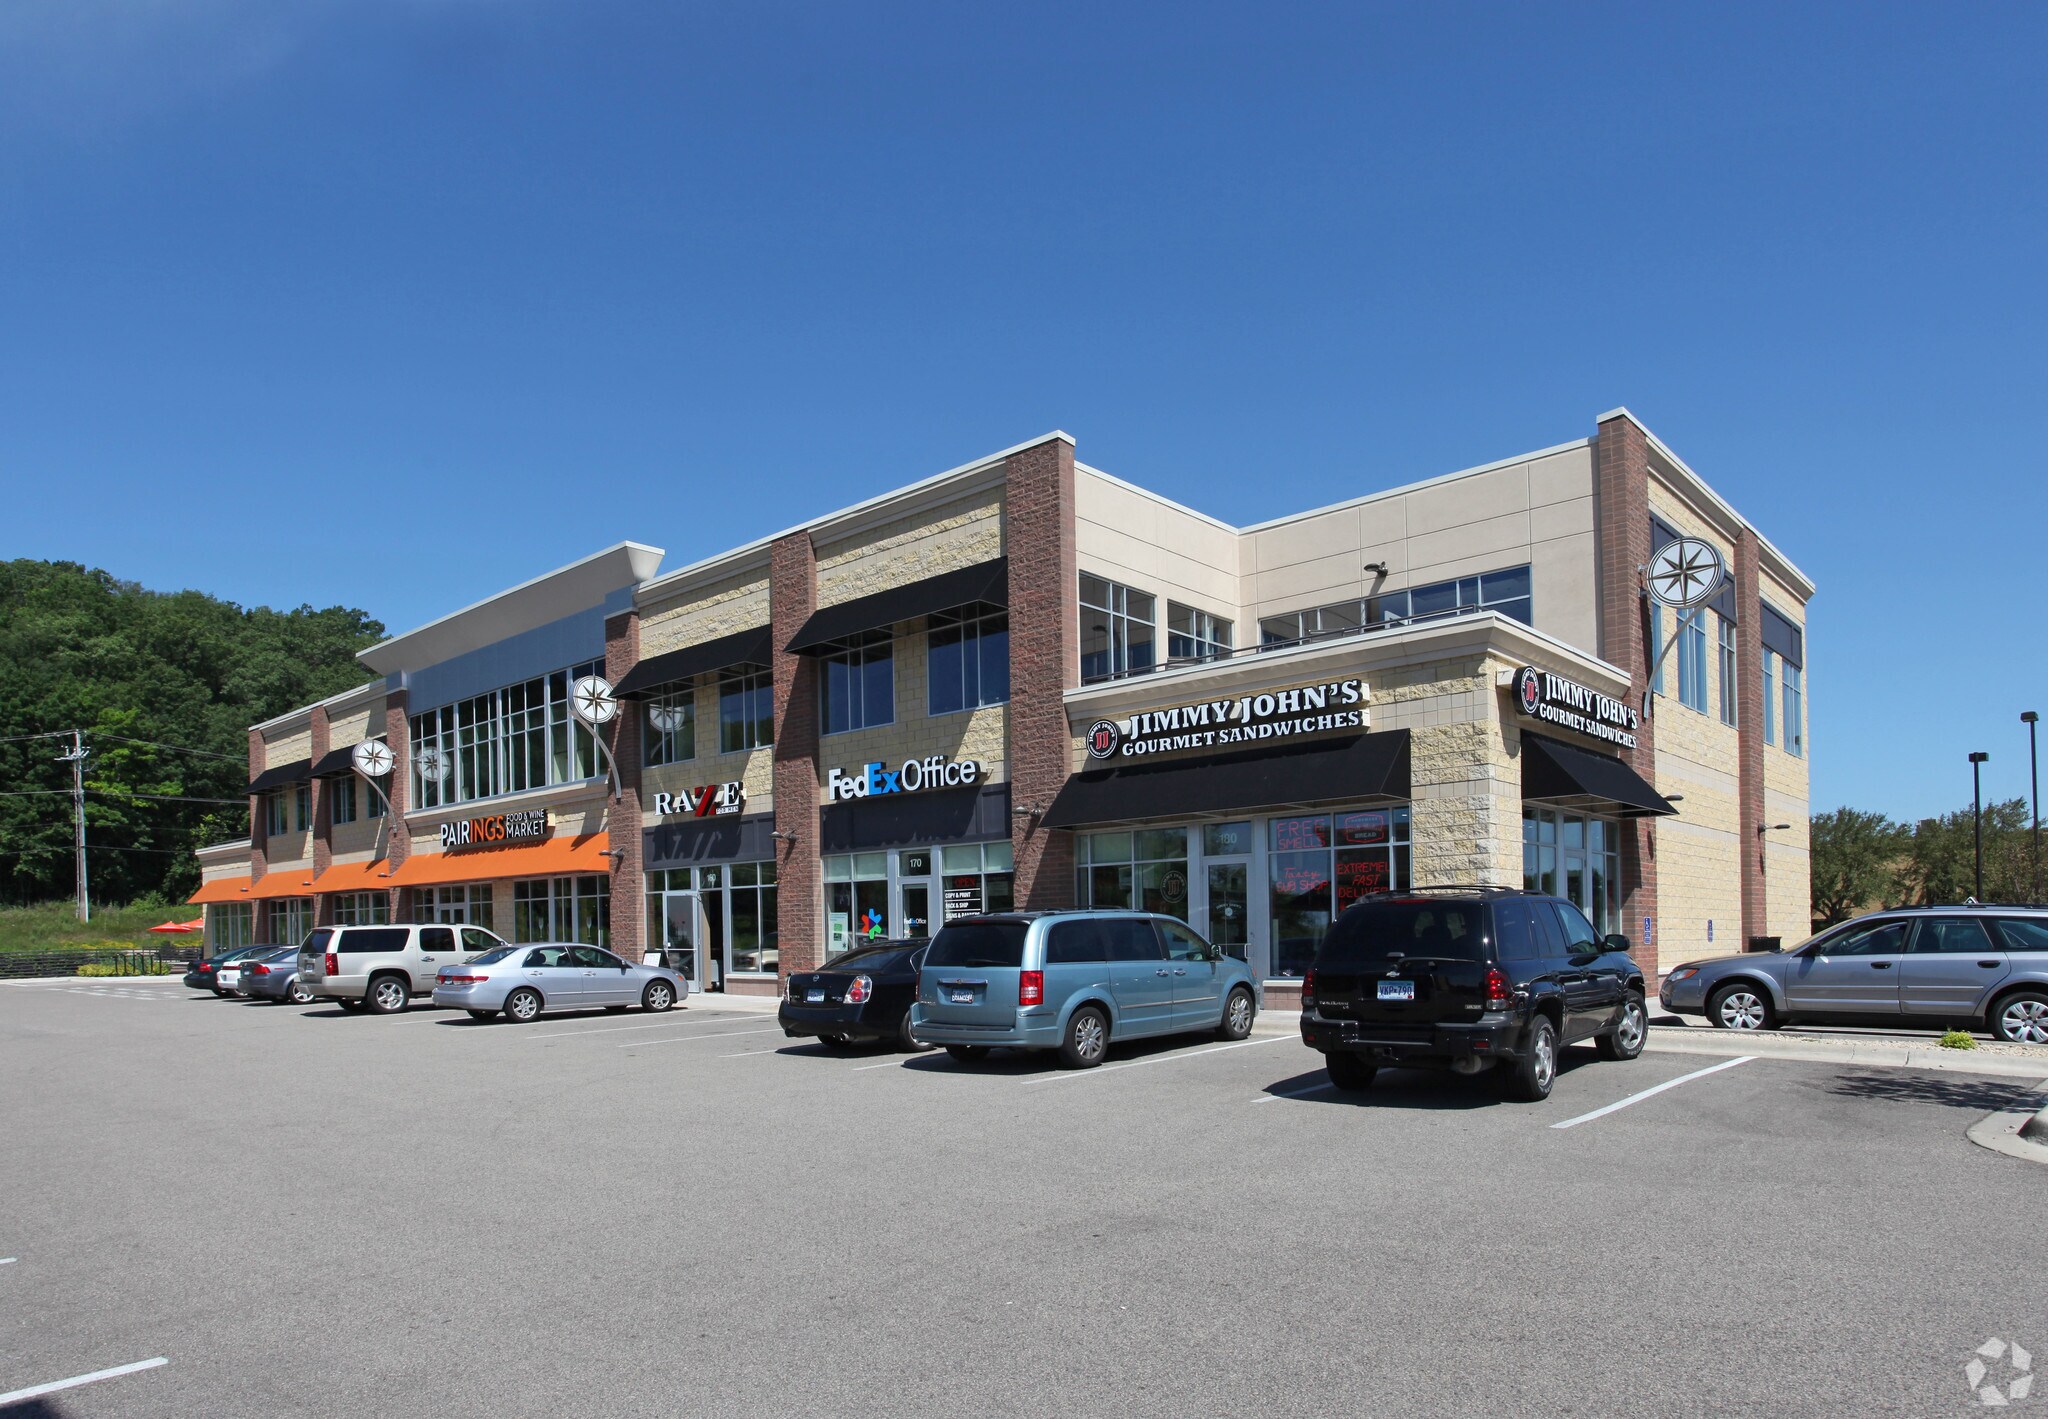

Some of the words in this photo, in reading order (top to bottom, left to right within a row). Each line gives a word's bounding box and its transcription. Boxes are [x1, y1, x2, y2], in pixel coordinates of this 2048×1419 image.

[1130, 700, 1230, 740] JIMMY
[1240, 680, 1360, 724] JOHN'S
[1545, 674, 1592, 712] JIMMY
[1596, 693, 1638, 730] JOHN'S
[1122, 731, 1216, 756] GOURMET
[1219, 710, 1360, 744] SANDWICHES
[1540, 702, 1585, 730] GOURMET
[1586, 719, 1637, 749] SANDWICHES
[828, 761, 900, 801] FedEx
[901, 755, 976, 791] Office
[653, 781, 740, 817] RAZE
[506, 812, 522, 823] FOOD
[529, 808, 544, 819] WINE
[440, 816, 504, 847] PAIRINGS
[506, 820, 545, 839] MARKET
[1219, 833, 1237, 844] 180
[1276, 818, 1325, 839] FREE
[1279, 833, 1327, 850] SMELLS
[910, 858, 922, 868] 170
[1335, 862, 1389, 875] EXTREMEL
[1276, 880, 1297, 893] SUB
[1300, 880, 1328, 892] SHOP
[1352, 874, 1380, 886] FAST
